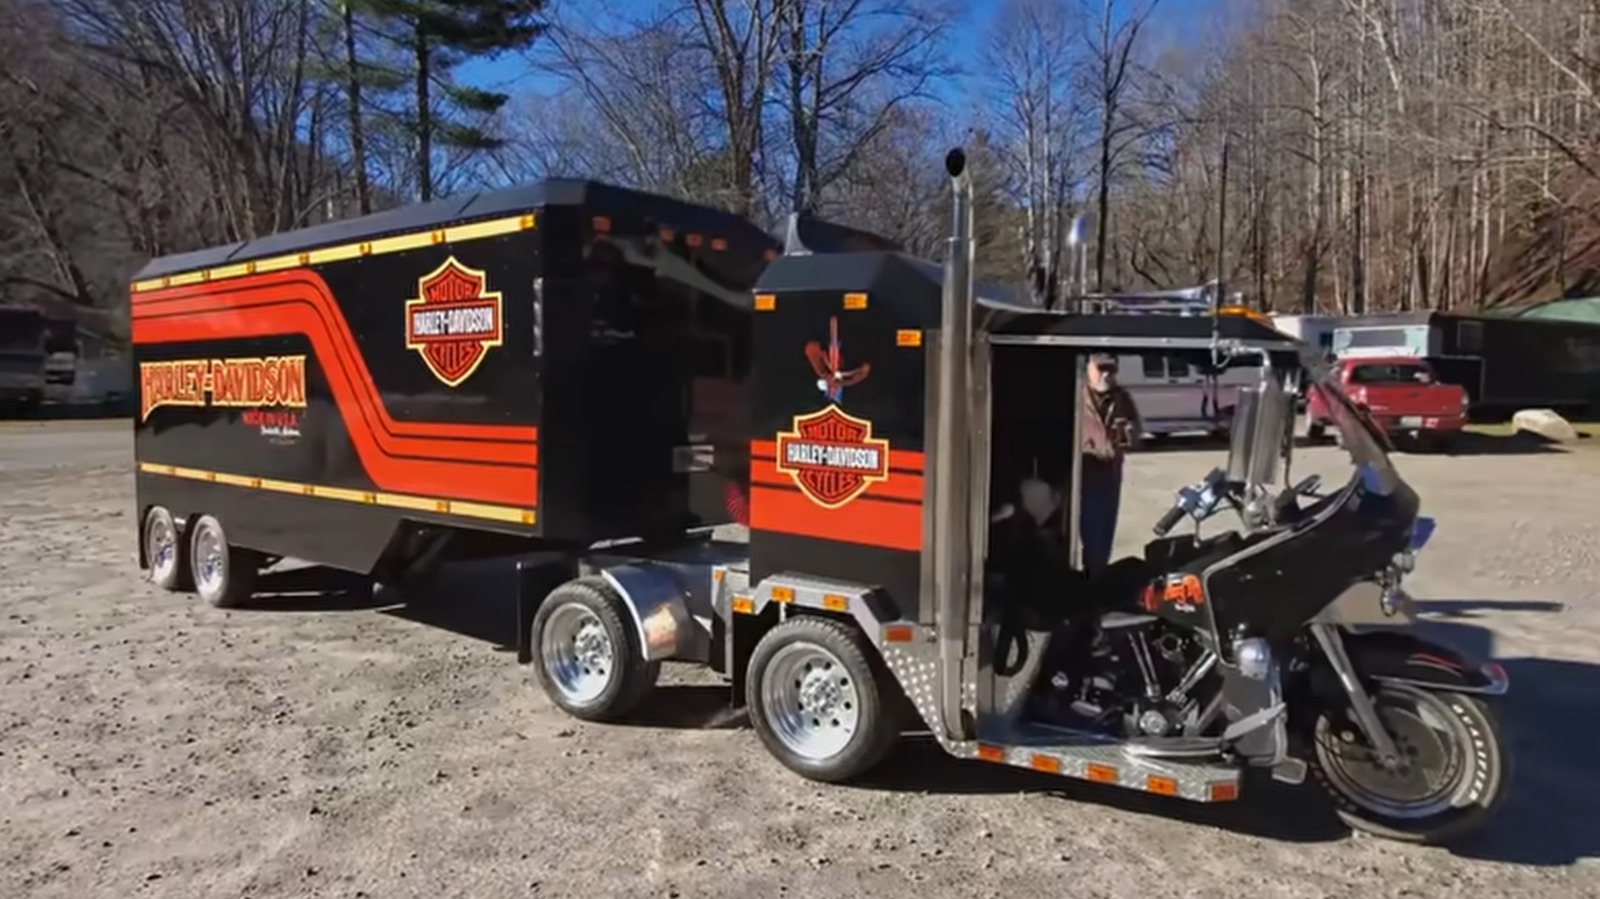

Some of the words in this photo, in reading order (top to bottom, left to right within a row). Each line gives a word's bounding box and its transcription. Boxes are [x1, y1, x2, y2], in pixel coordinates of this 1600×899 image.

[429, 278, 474, 300] MOTOR
[412, 306, 493, 335] HARLEY-DAVIDSON
[140, 355, 307, 423] HARLEY-DAVIDSON
[807, 418, 857, 441] MOTOR
[786, 442, 879, 470] HARLEY-DAVIDSON
[806, 470, 857, 497] CYCLES
